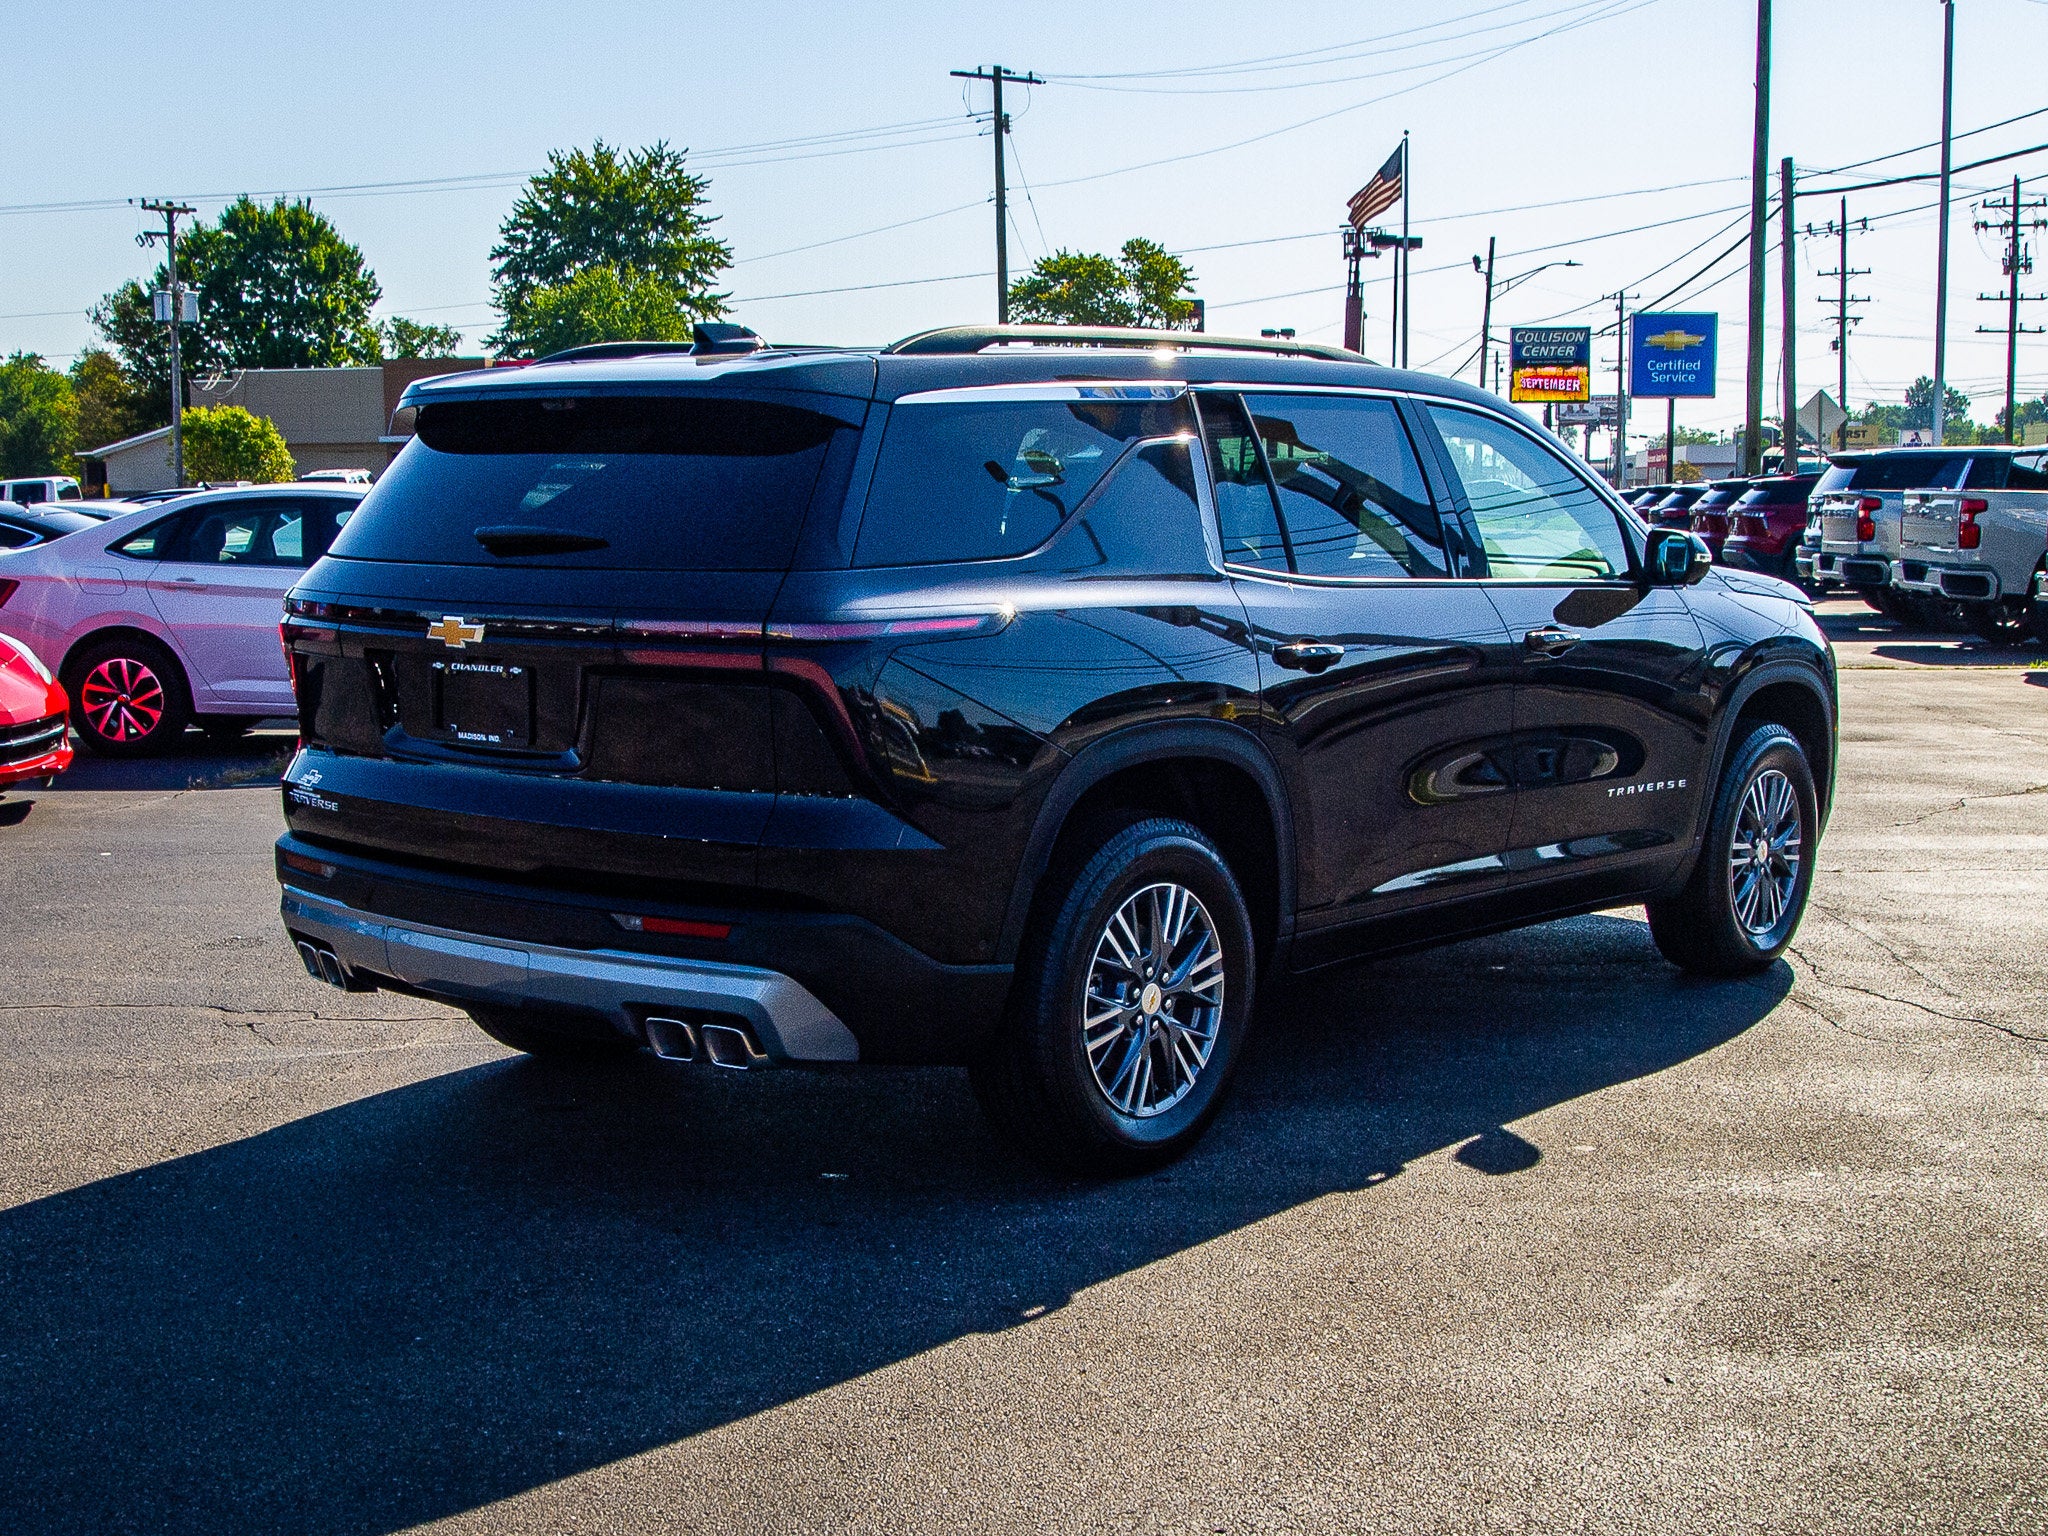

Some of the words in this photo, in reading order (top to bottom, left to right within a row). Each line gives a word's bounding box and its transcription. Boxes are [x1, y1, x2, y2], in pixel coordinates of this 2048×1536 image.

[1514, 330, 1587, 343] COLLISION
[1521, 345, 1576, 357] CENTER
[1647, 359, 1701, 371] Certified
[1651, 372, 1696, 383] Service
[1520, 377, 1581, 391] SEPTEMBER
[451, 662, 504, 673] CHANDLER
[1607, 779, 1687, 798] TRAVERSE
